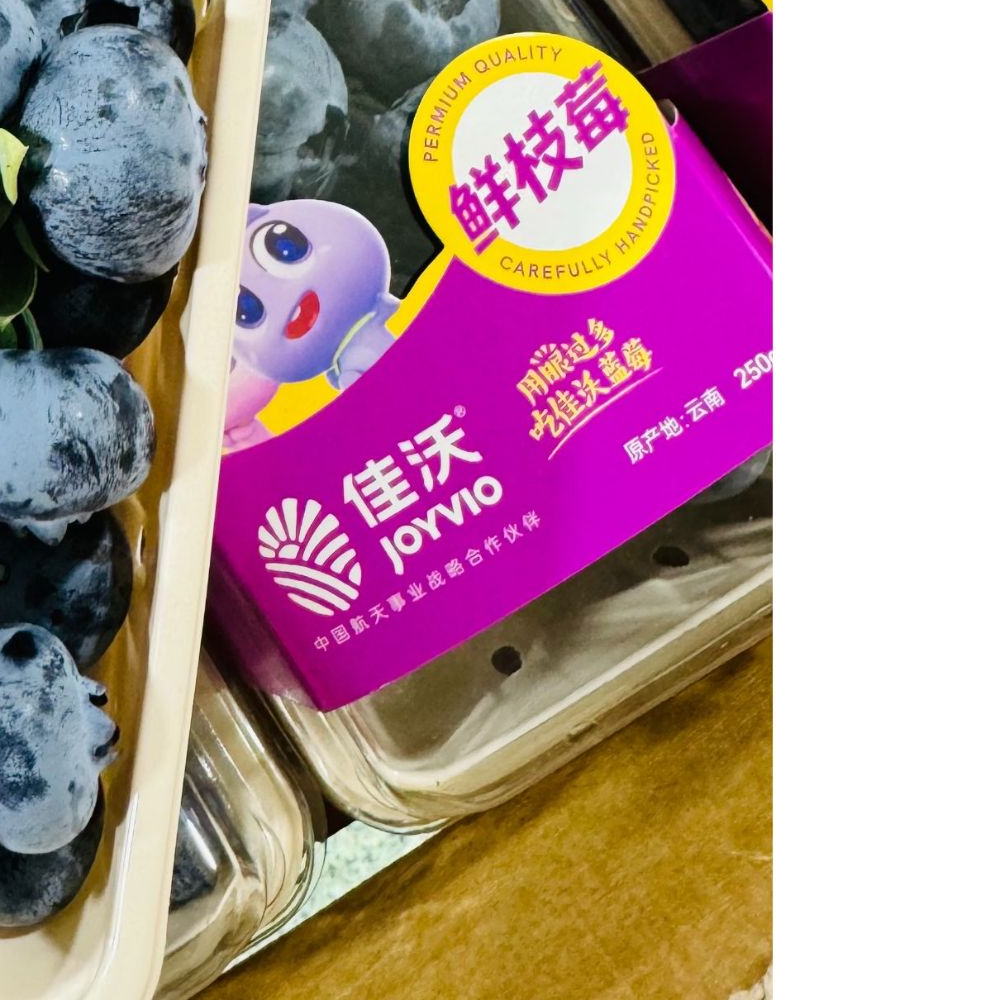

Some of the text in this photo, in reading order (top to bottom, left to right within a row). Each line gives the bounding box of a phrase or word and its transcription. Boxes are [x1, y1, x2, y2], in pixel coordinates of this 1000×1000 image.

[423, 45, 563, 163] PERMIUM QUALITY
[448, 60, 631, 256] 鲜枝莓
[499, 131, 661, 280] CAREFULLY HANDPICKED
[516, 317, 615, 407] 用眼过多
[528, 337, 653, 441] 吃佳沃蓝莓
[313, 509, 542, 653] 中国航天事业战略合作伙伴
[379, 475, 503, 576] JOYVIO
